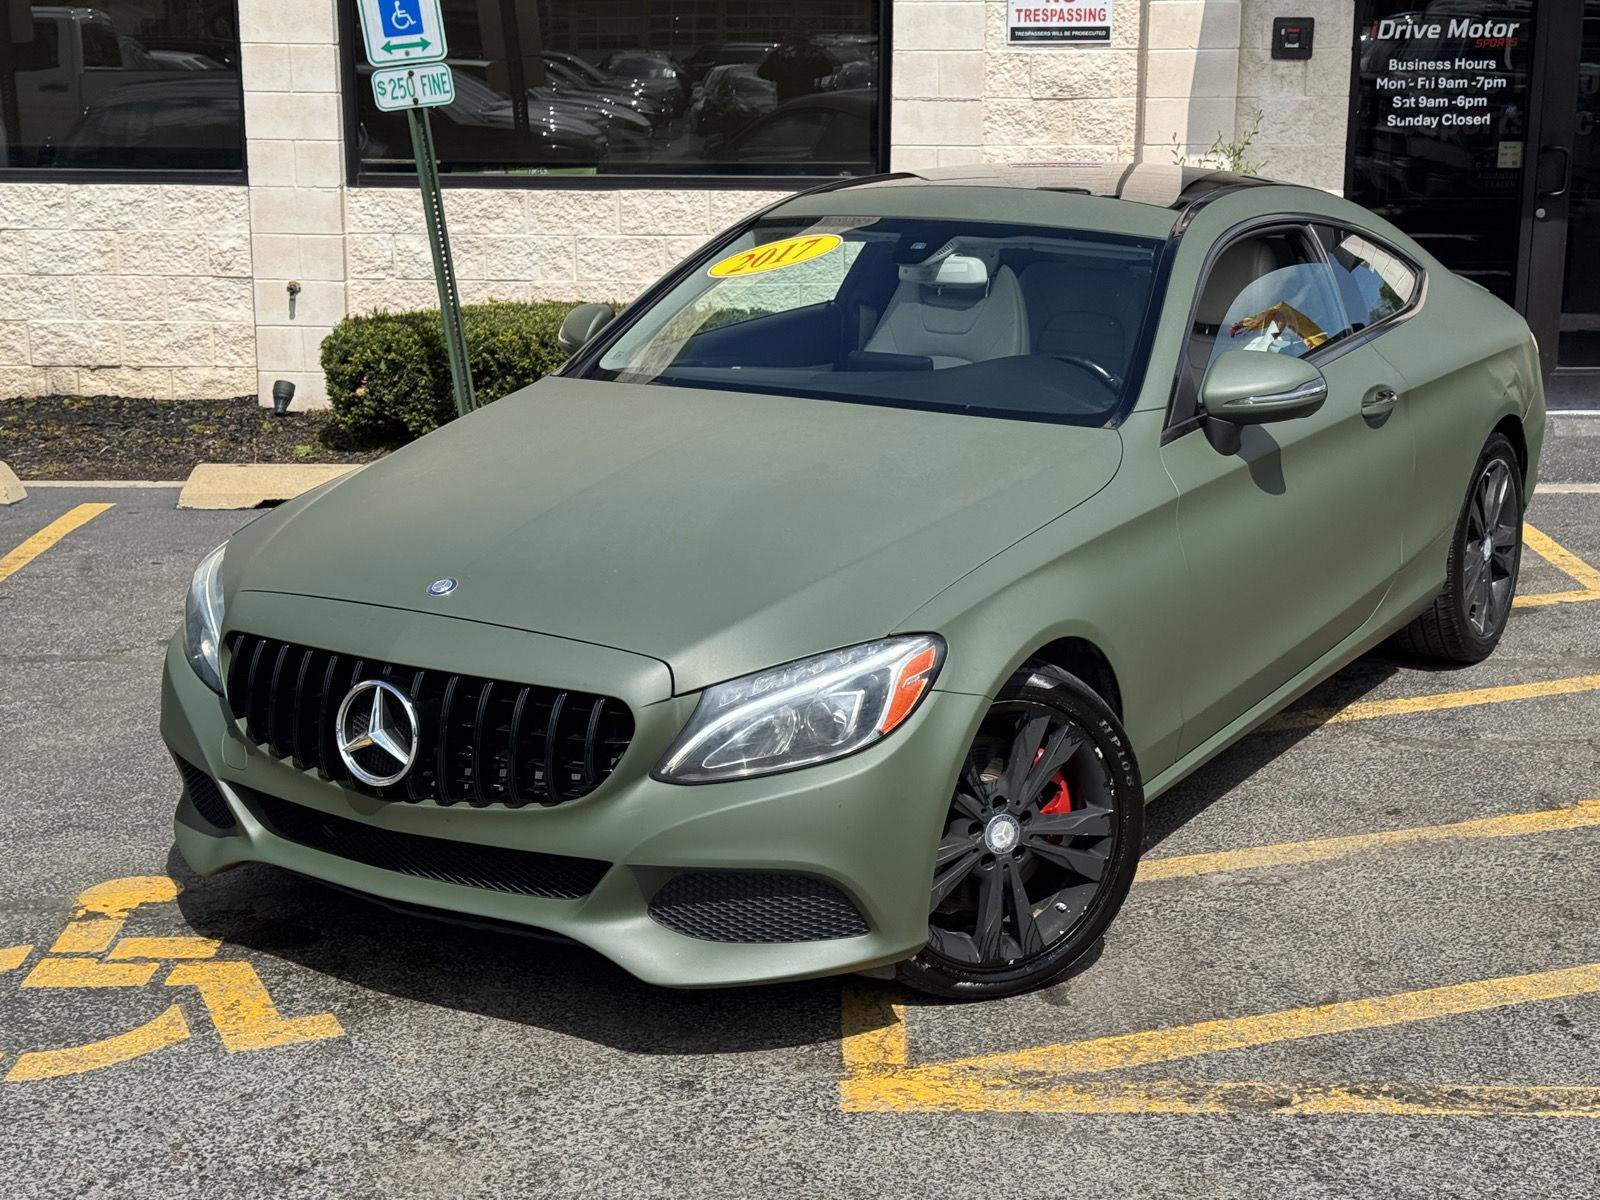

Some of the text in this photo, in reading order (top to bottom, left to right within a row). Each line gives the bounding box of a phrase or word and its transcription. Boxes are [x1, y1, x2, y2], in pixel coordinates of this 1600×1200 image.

[1015, 8, 1107, 22] TRESPASSING
[1447, 18, 1520, 38] Motor
[1475, 37, 1519, 48] SPORTS
[1388, 57, 1497, 70] Business Hours
[420, 72, 451, 97] FINE
[1376, 77, 1406, 90] Mon
[1417, 76, 1435, 89] Fri
[1437, 77, 1468, 89] 9am
[1471, 76, 1507, 91] -7pm
[1392, 95, 1488, 110] Sat 9am -6pm
[1387, 112, 1491, 129] Sunday Closed
[725, 237, 824, 275] 2017
